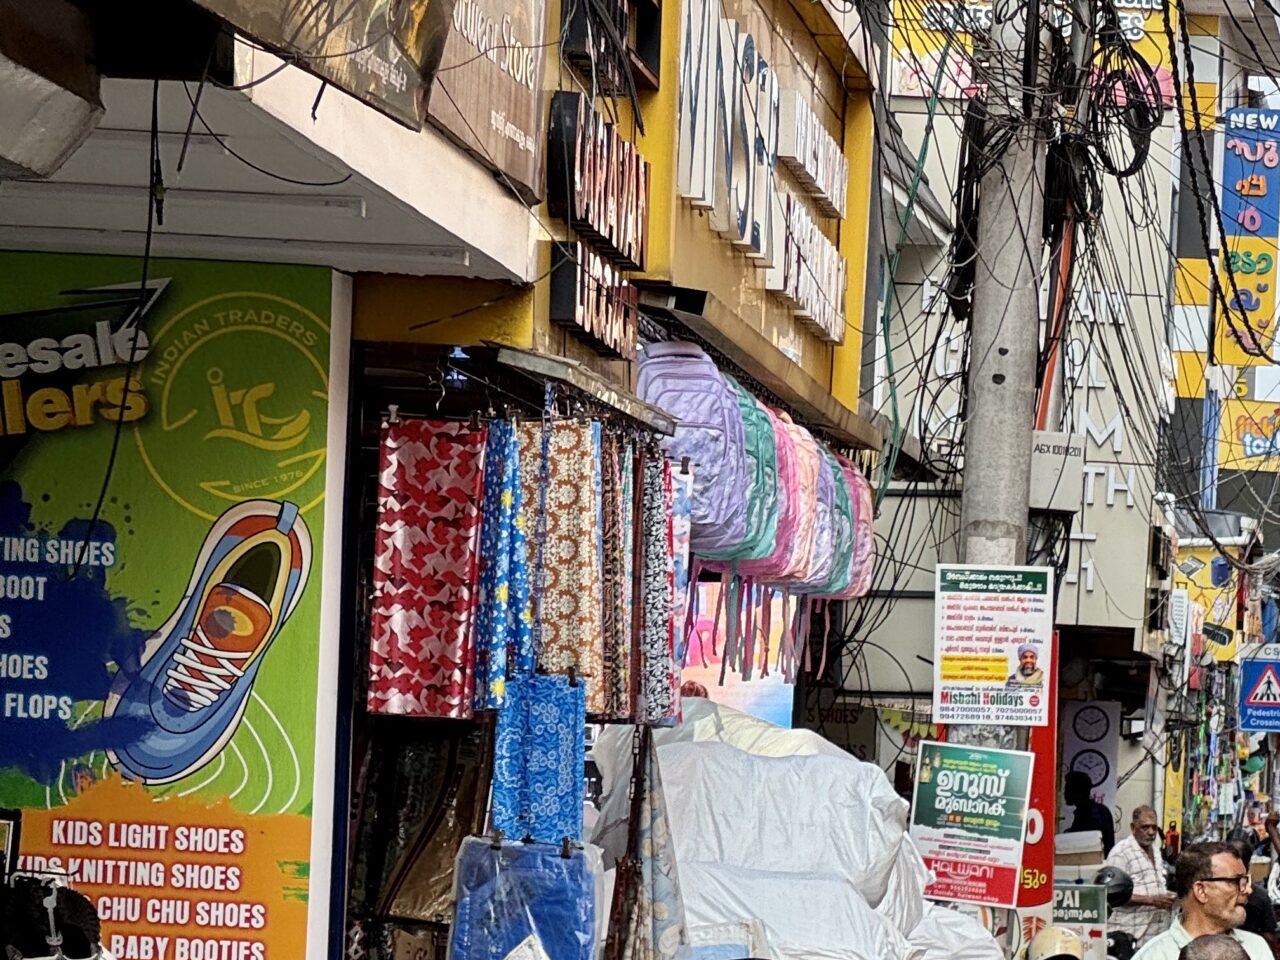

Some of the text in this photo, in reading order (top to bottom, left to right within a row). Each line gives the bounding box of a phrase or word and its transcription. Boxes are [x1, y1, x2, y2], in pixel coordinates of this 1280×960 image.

[1230, 113, 1279, 130] NEW
[151, 309, 318, 386] INDIAN TRADERS
[46, 539, 115, 566] SHOES
[5, 692, 72, 719] FLOPS
[983, 692, 1024, 707] Holidays
[53, 820, 244, 853] KIDS LIGHT SHOES
[68, 858, 164, 887] KNITTING
[171, 863, 240, 891] SHOES
[98, 896, 265, 928] CHU CHU SHOES
[111, 934, 169, 960] BABY
